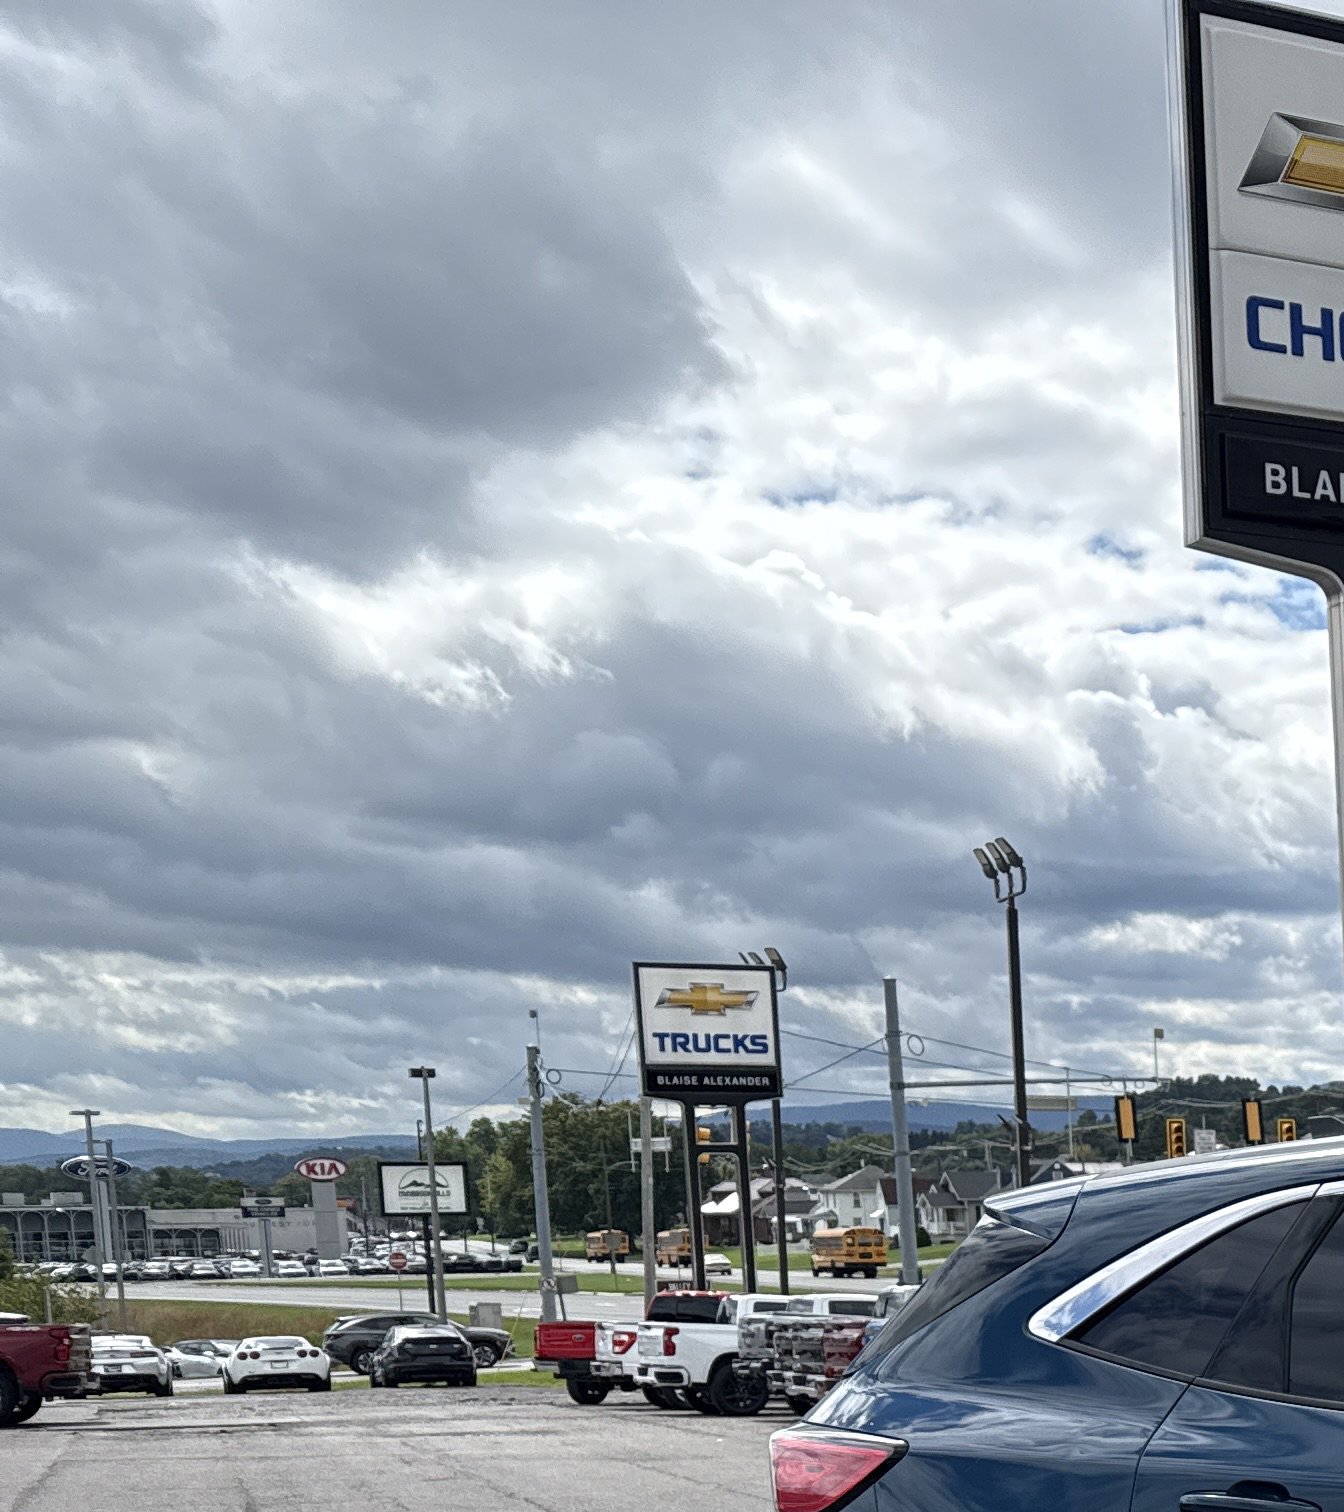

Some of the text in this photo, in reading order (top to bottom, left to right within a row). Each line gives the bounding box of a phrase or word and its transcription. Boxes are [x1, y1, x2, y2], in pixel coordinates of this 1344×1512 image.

[652, 1032, 769, 1054] TRUCKS
[657, 1075, 770, 1087] BLAISE ALEXANDER
[305, 1162, 341, 1176] KIA
